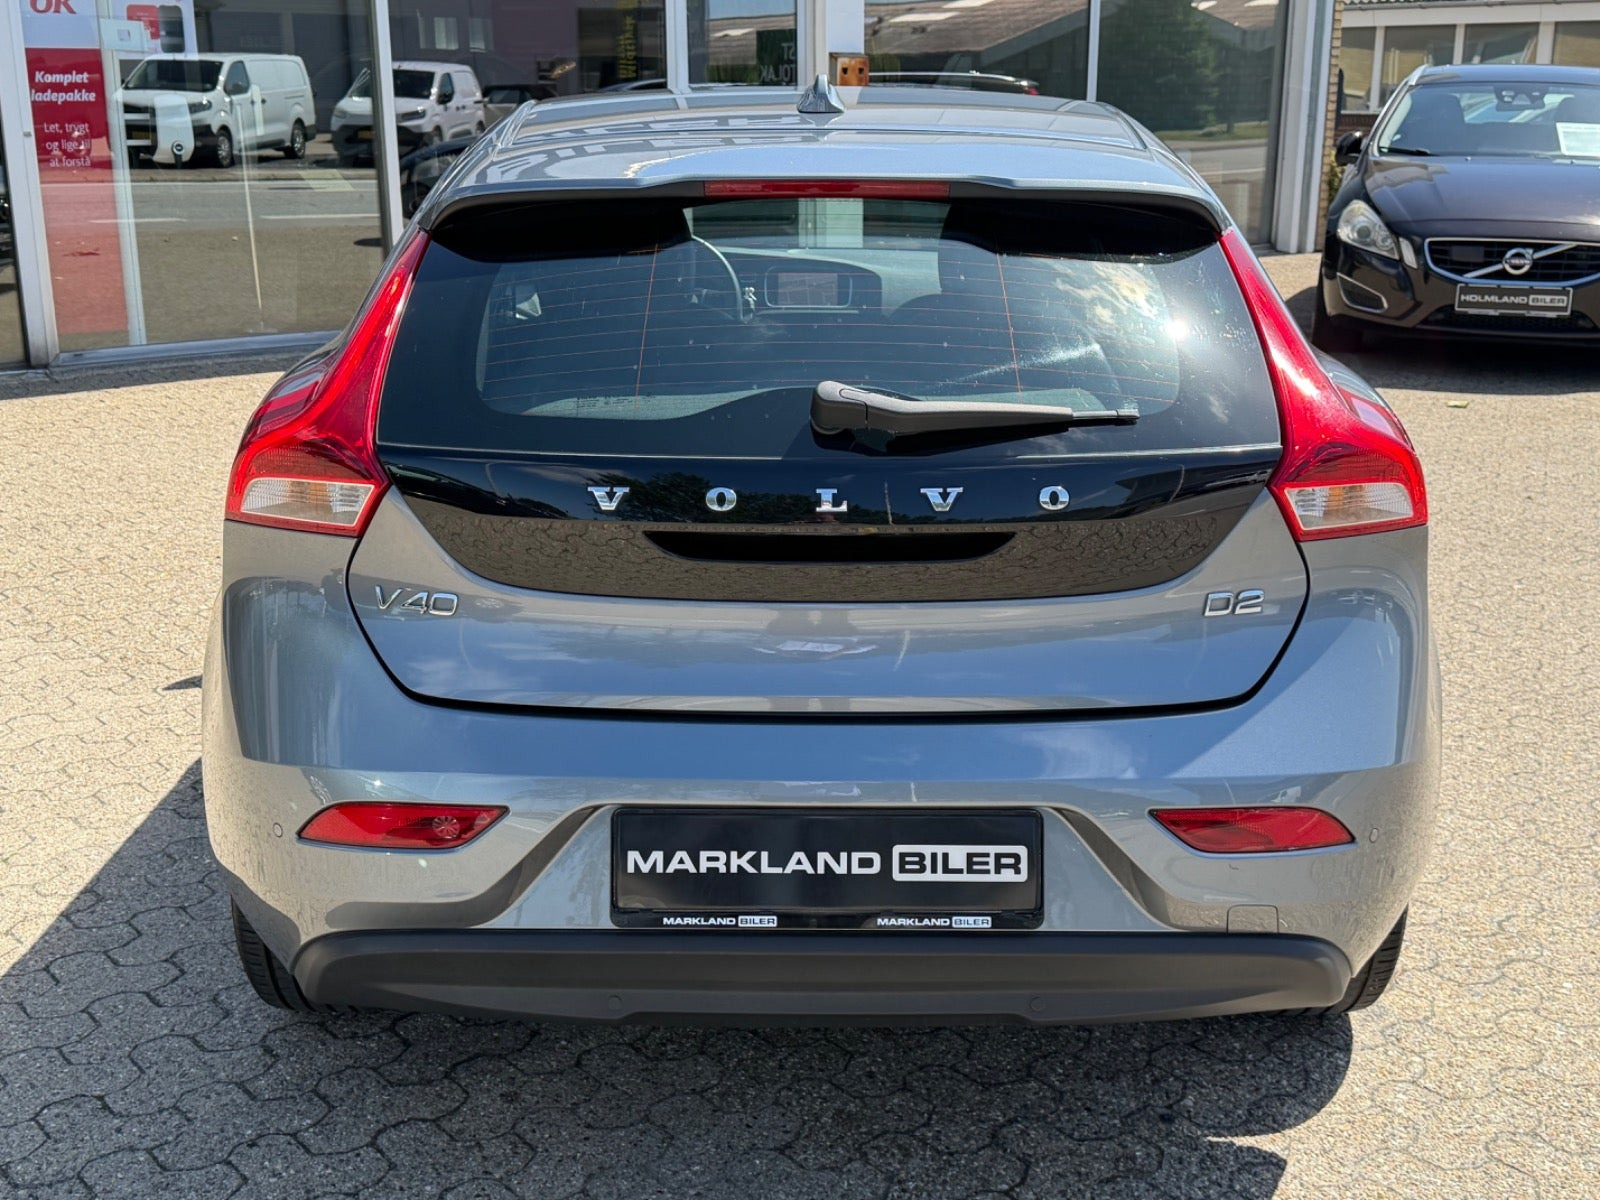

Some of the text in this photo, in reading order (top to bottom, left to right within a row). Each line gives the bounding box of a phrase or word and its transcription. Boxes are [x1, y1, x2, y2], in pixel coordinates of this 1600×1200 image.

[35, 70, 89, 86] Komplet
[31, 89, 96, 105] ladepakke
[44, 123, 90, 135] Let, trygt
[46, 142, 59, 153] og
[61, 139, 78, 152] lige
[49, 157, 91, 168] at forstå
[1532, 296, 1565, 305] BILER
[587, 486, 1070, 512] VOLVO
[375, 585, 459, 616] V40
[1204, 589, 1265, 617] D2
[626, 850, 1023, 876] MARKLAND BILER
[662, 916, 776, 926] MARKLAND BILER
[876, 917, 990, 927] MARKLAND BILER
